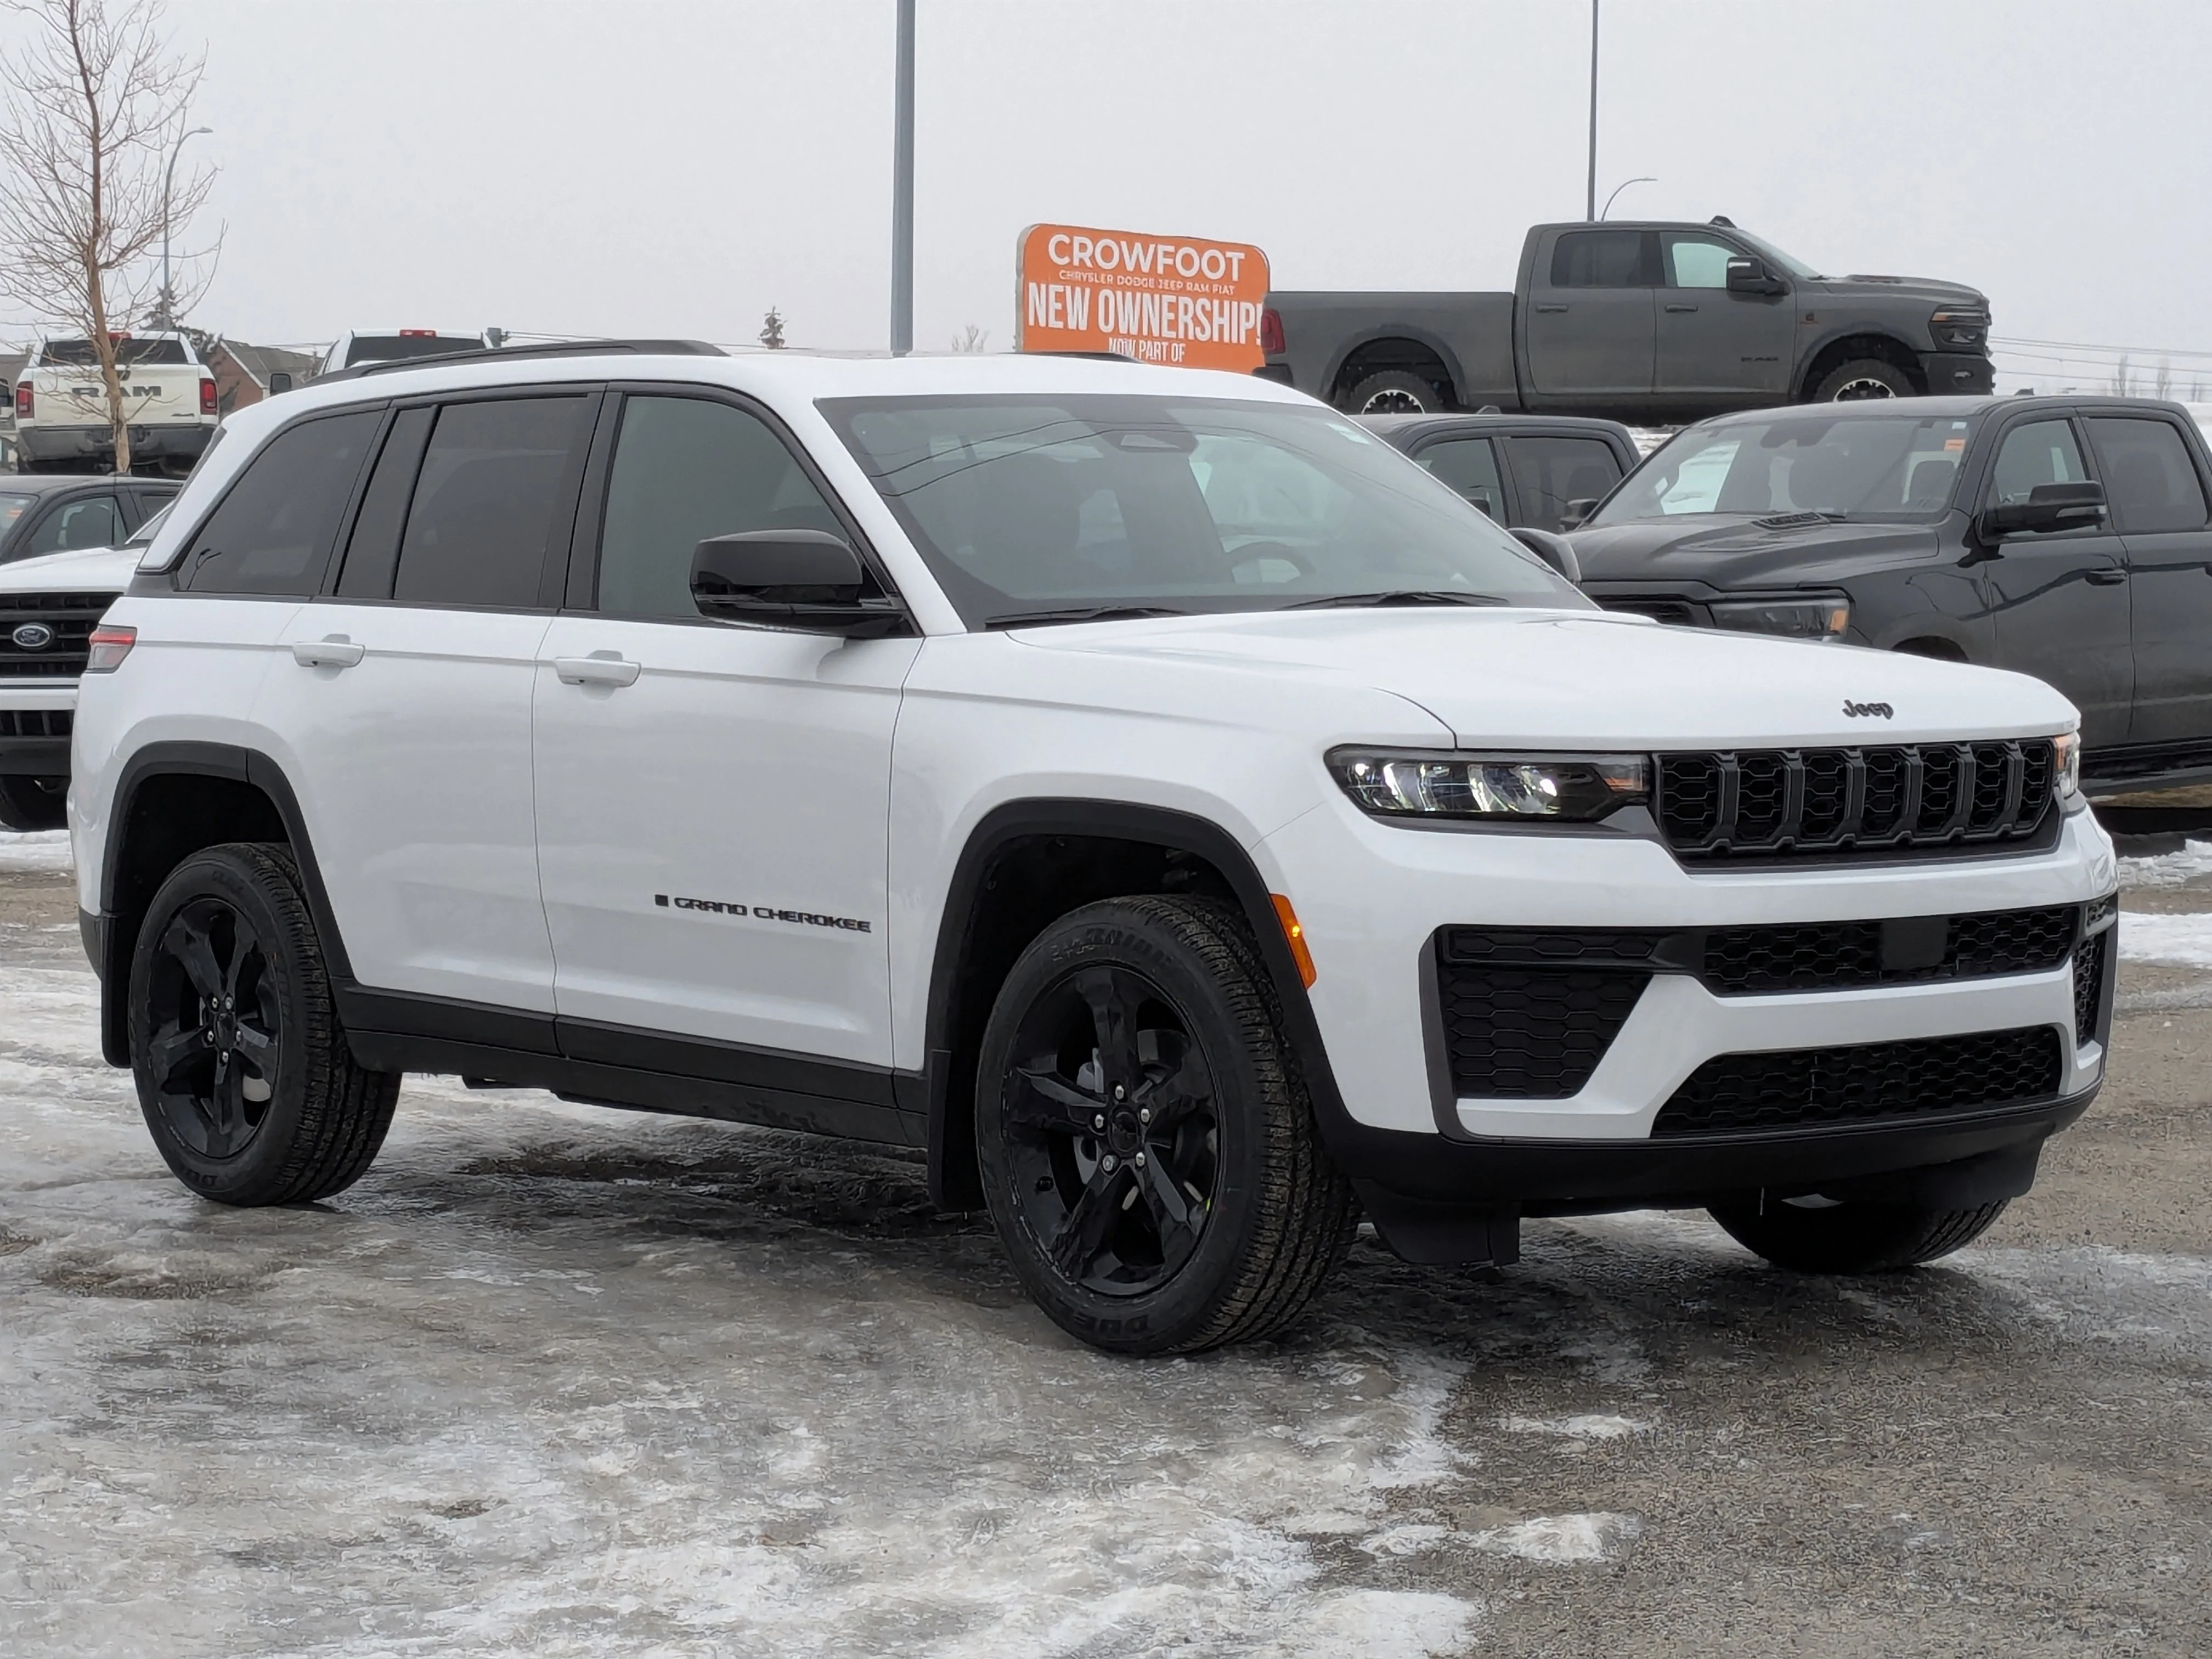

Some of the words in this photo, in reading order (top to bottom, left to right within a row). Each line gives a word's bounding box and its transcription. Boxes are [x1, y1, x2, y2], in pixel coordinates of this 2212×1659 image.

[1048, 233, 1245, 281] CROWFOOT
[1059, 269, 1114, 285] CHRYSLER
[1116, 275, 1155, 288] DODGE
[1212, 285, 1235, 295] FIAT
[1029, 282, 1091, 331] NEW
[1098, 289, 1263, 346] OWNERSHIP!
[1108, 337, 1136, 359] NOW
[1139, 339, 1169, 362] PART
[1171, 341, 1186, 363] OF
[1842, 699, 1894, 720] Jeep
[674, 896, 747, 916] GRAND
[753, 906, 872, 933] CHEROKEE
